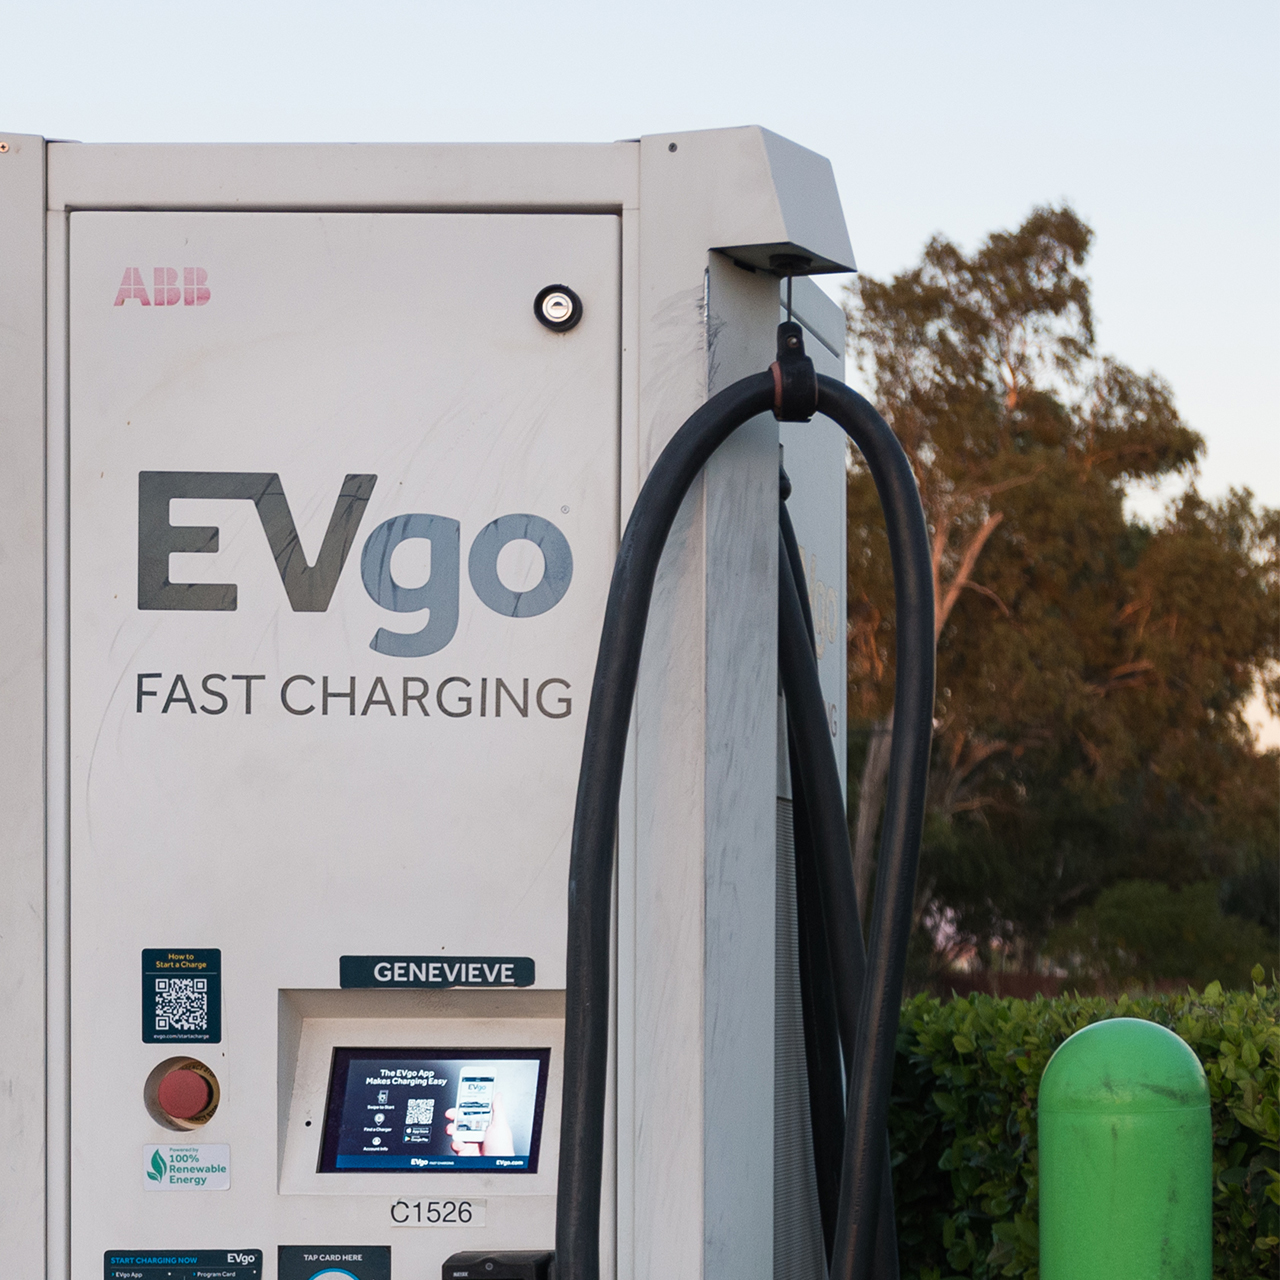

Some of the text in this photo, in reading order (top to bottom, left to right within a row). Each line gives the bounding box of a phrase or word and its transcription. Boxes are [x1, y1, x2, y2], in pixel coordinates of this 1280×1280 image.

[113, 266, 212, 307] ABB
[137, 470, 574, 659] EVgo
[136, 673, 573, 719] FAST CHARGING
[180, 961, 207, 970] Charge
[373, 962, 515, 983] GENEVIEVE
[380, 1069, 435, 1078] The EVgo App
[391, 1078, 427, 1086] Charging
[428, 1078, 448, 1086] Easy
[467, 1083, 487, 1091] EVgo
[169, 1154, 200, 1163] 100%
[410, 1158, 429, 1167] EVgo
[169, 1164, 227, 1173] Renewable
[169, 1175, 207, 1186] Energy
[390, 1200, 473, 1223] C1526
[227, 1253, 256, 1265] EVgo
